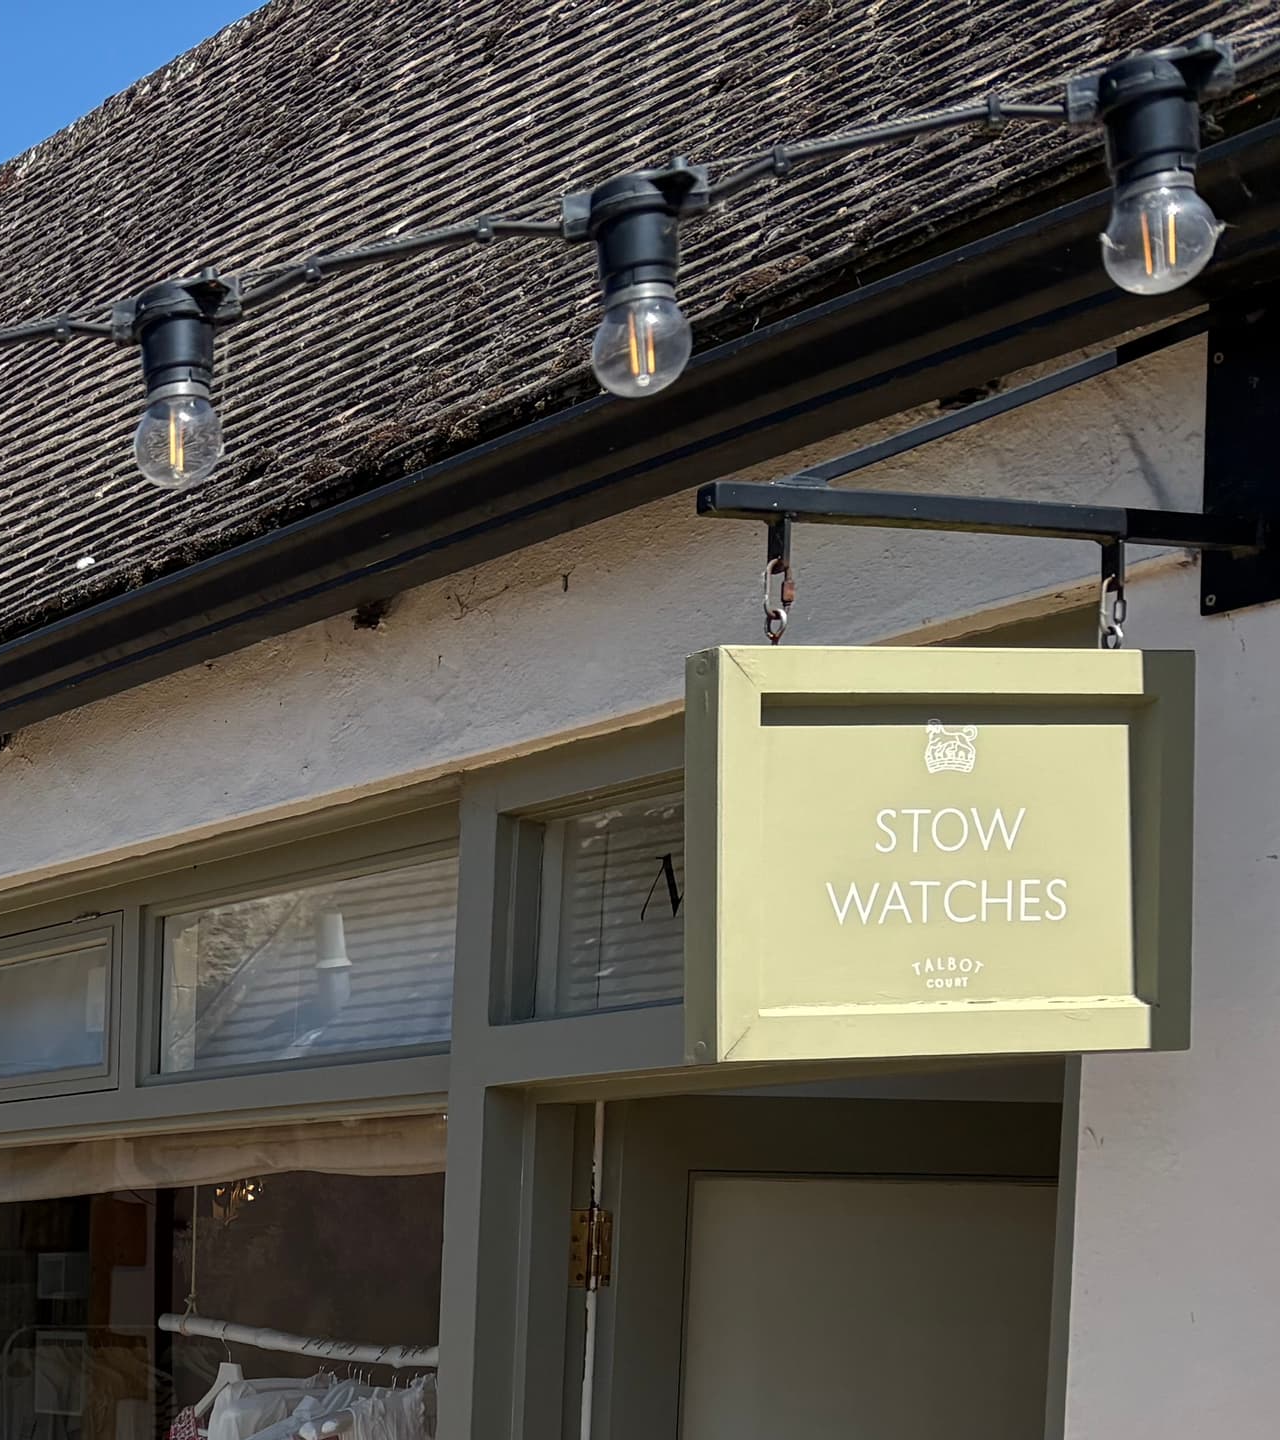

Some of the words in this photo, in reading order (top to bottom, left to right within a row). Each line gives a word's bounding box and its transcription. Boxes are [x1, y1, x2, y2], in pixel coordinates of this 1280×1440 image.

[874, 807, 1027, 853] STOW
[825, 879, 1068, 925] WATCHES
[911, 956, 984, 976] TALBOT
[926, 977, 969, 988] COURT
